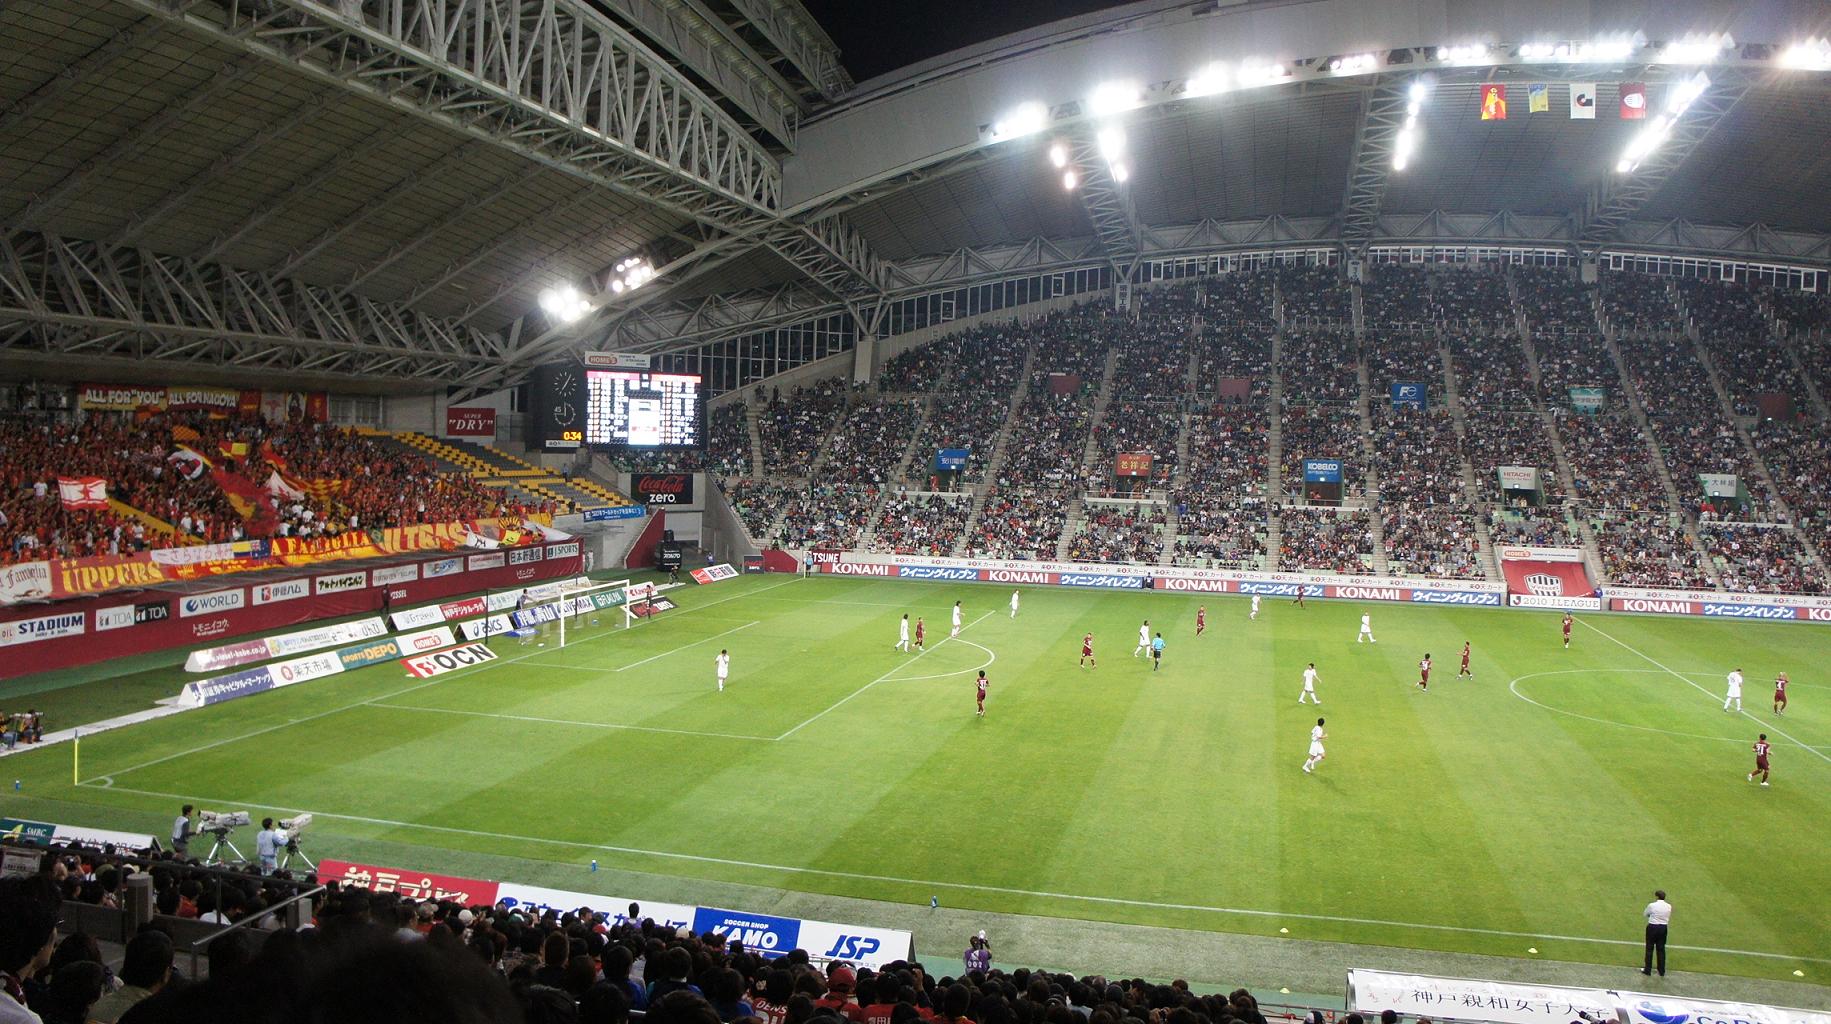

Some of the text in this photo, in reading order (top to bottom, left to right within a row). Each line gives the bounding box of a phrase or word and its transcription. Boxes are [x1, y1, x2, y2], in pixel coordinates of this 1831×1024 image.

[85, 389, 107, 403] ALL
[108, 390, 132, 404] FOR
[168, 392, 185, 405] ALL
[1307, 462, 1338, 471] KOBELCO
[813, 552, 840, 563] TSUNE
[831, 562, 889, 576] KONAMI
[988, 570, 1048, 583] KONAMI
[1165, 578, 1227, 592] KONAMI
[1335, 586, 1400, 600] KONAMI
[200, 594, 239, 609] WORLD
[1523, 597, 1549, 606] 2010
[1623, 599, 1691, 614] KONAMI
[114, 612, 132, 624] TOA
[148, 606, 167, 620] TOA
[18, 615, 83, 634] STADIUM
[365, 643, 398, 661] DEPO
[433, 644, 494, 670] OCN
[724, 919, 769, 930] SOCCER SHOP
[712, 925, 779, 949] KAMO
[825, 934, 881, 960] JSP
